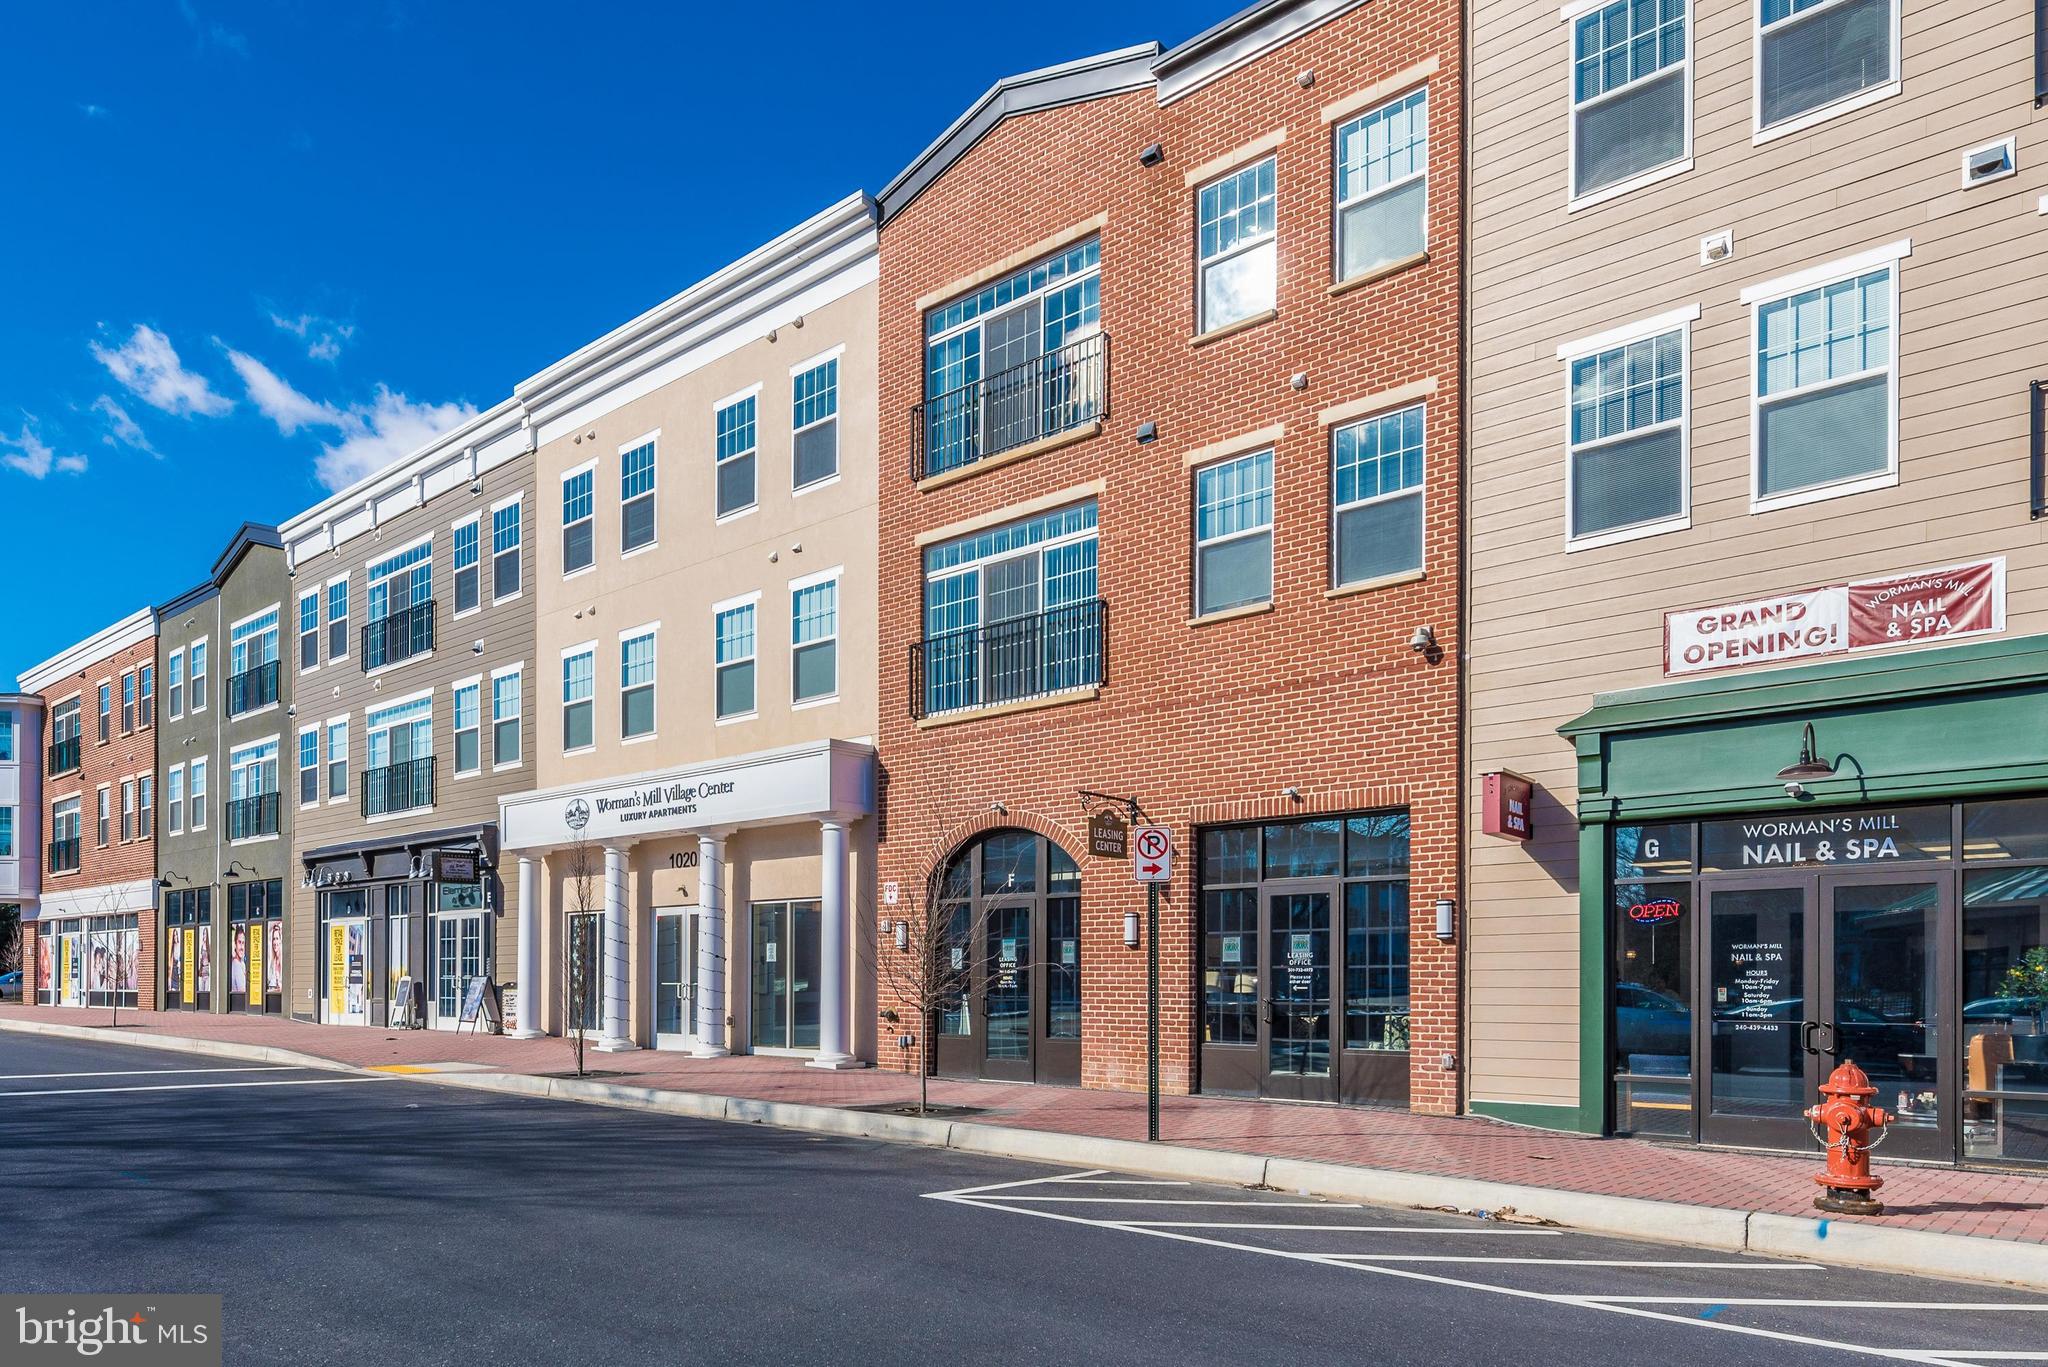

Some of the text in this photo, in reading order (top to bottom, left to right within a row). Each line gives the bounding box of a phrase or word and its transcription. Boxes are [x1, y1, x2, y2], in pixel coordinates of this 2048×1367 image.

[1865, 578, 1974, 609] WORMAN'S MILL
[1696, 601, 1807, 635] GRAND
[1891, 598, 1947, 618] NAIL
[1886, 614, 1953, 638] & SPA
[1683, 623, 1838, 664] OPENING!
[596, 781, 735, 814] Worman's Mill Village Center
[620, 804, 697, 822] LUXURY APARTMENTS
[1093, 827, 1124, 841] LEASING
[1743, 815, 1900, 838] WORMAN'S MILL
[1095, 840, 1122, 853] CENTER
[1644, 838, 1660, 859] G
[1742, 837, 1900, 865] NAIL & SPA
[669, 851, 698, 869] 1020
[884, 884, 897, 892] FDC
[1008, 873, 1015, 888] F
[1629, 902, 1680, 919] OPEN
[1731, 953, 1783, 961] NAIL & SPA
